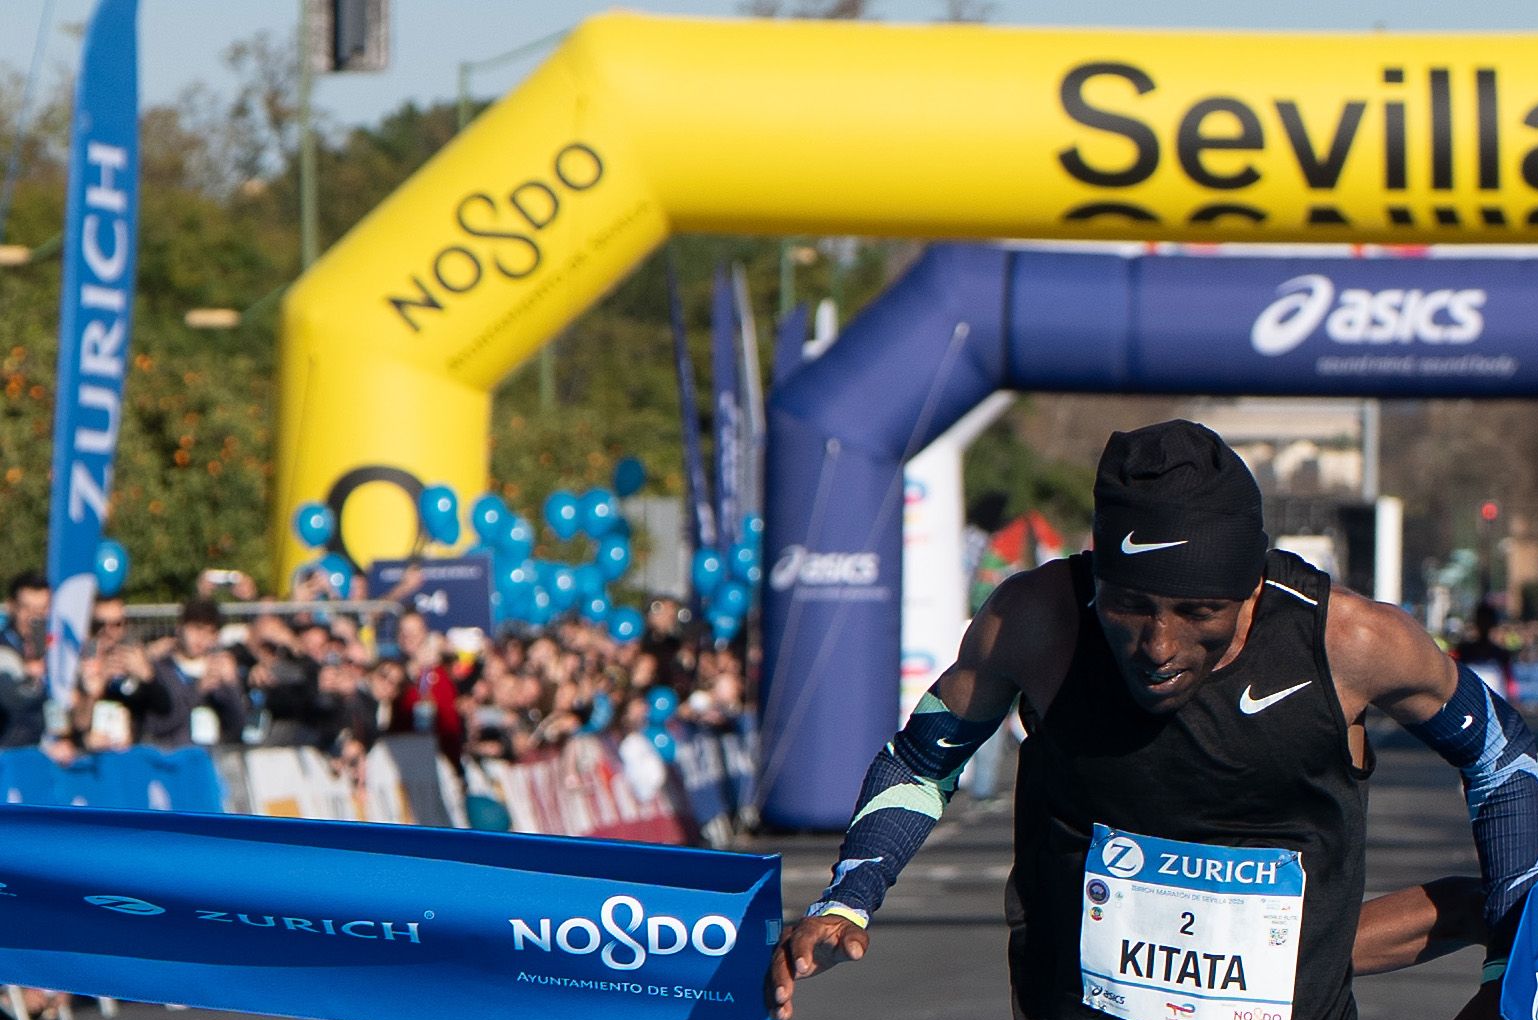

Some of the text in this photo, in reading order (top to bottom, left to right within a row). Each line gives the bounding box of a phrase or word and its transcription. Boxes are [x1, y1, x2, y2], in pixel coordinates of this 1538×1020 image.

[69, 141, 128, 525] ZURICH
[1326, 288, 1488, 345] asics
[1158, 853, 1277, 885] ZURICH
[196, 909, 421, 945] ZURICH
[1180, 911, 1195, 935] 2
[1119, 939, 1247, 991] KITATA
[517, 971, 735, 1003] AYUNTAMIENTO DE SEVILLA
